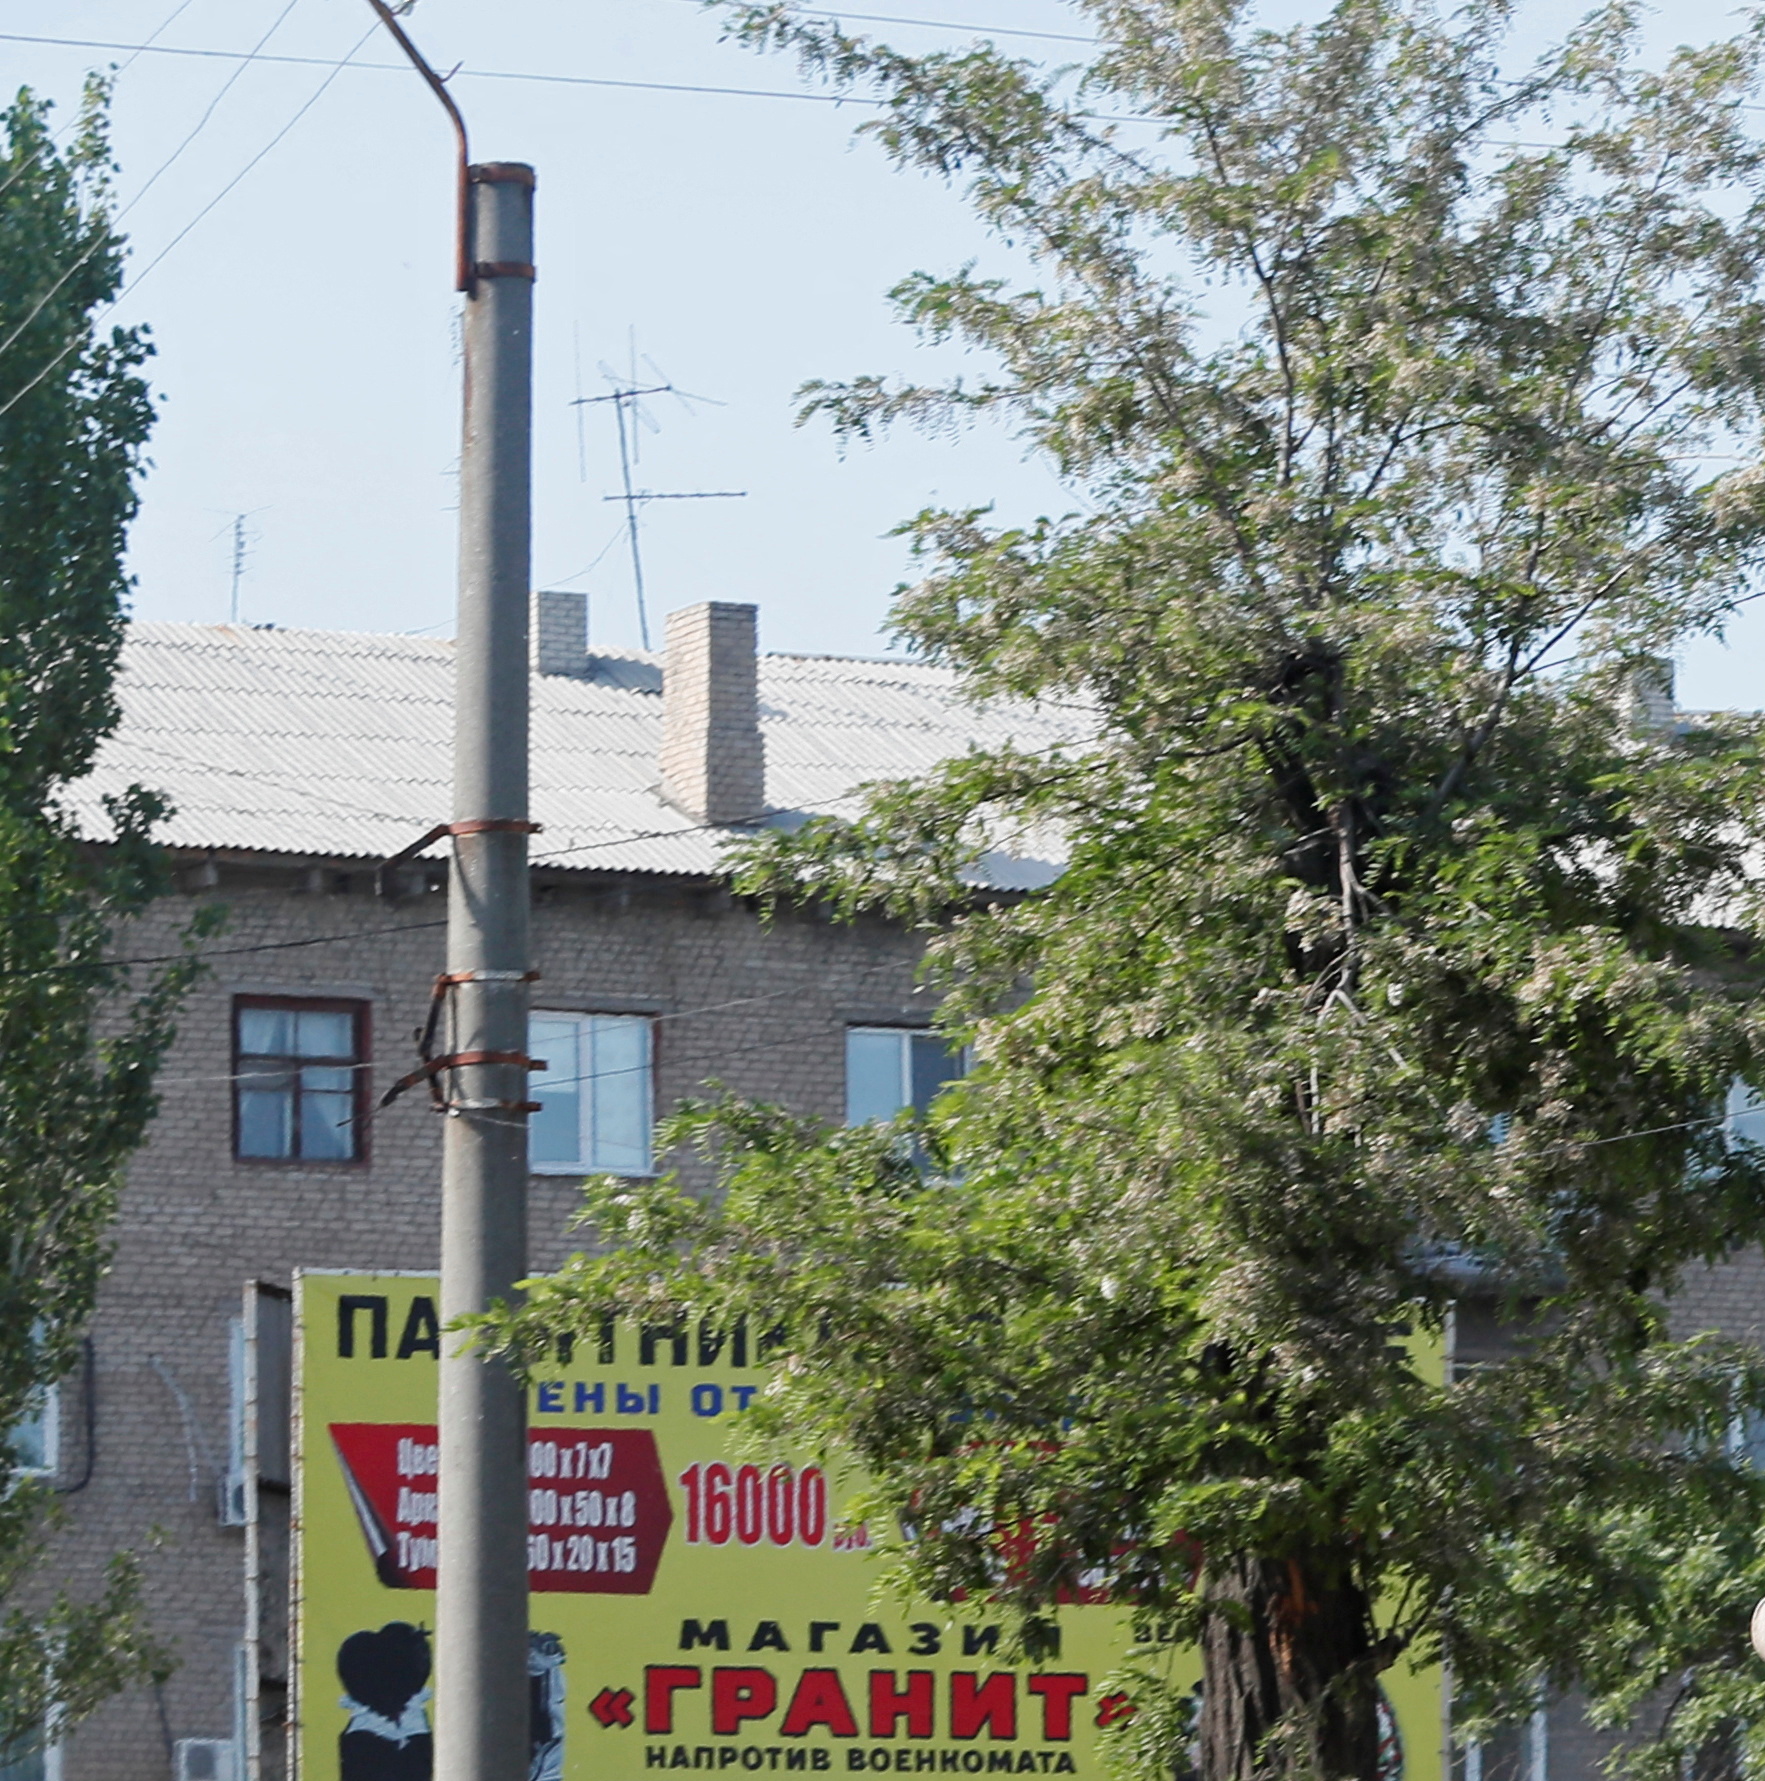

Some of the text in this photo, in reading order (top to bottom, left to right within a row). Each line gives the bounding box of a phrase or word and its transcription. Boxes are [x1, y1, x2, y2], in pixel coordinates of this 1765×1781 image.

[537, 1381, 758, 1418] ЕНЫ ОТ
[397, 1437, 438, 1480] Цве
[678, 1460, 830, 1547] 16000
[646, 1744, 1077, 1776] НАПРОТИВ ВОЕНКОМАТА
